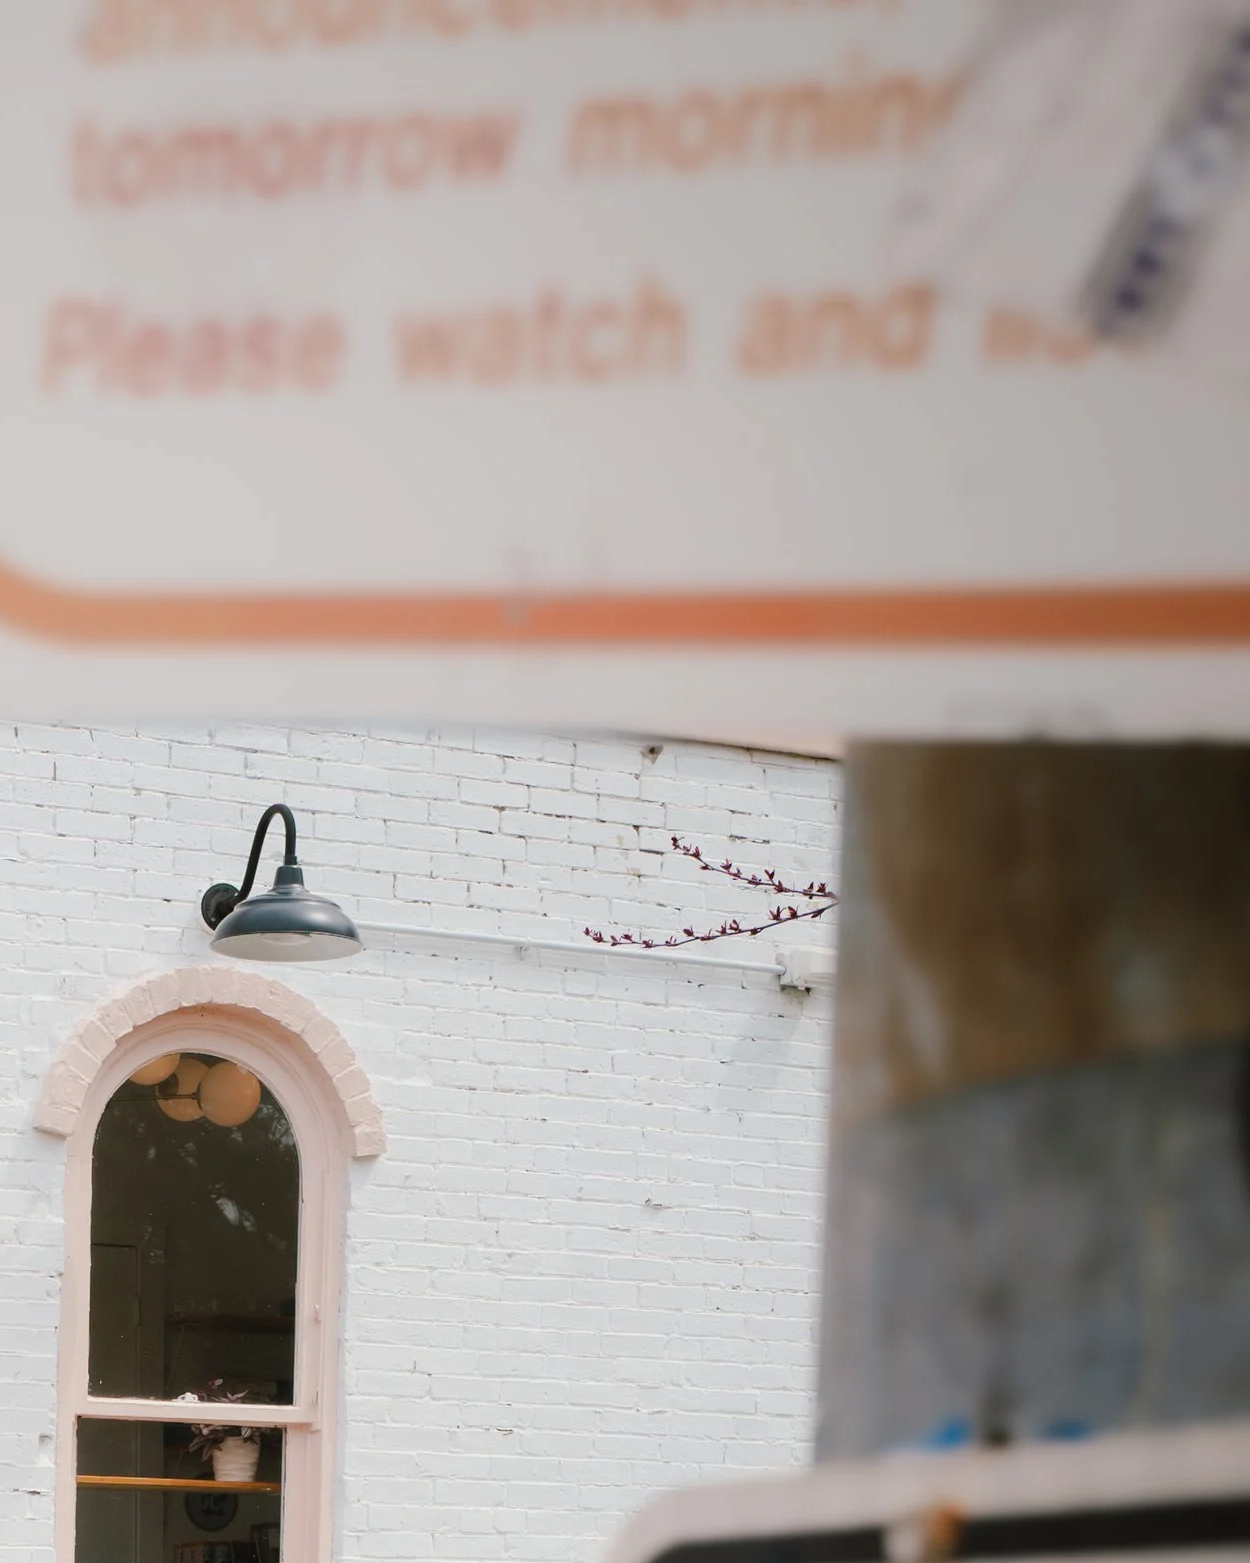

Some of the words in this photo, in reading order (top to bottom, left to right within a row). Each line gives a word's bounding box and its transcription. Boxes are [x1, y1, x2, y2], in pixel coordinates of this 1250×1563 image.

[70, 110, 520, 206] tomorrow
[38, 296, 350, 402] Please
[390, 276, 688, 388] watch
[735, 276, 936, 376] and
